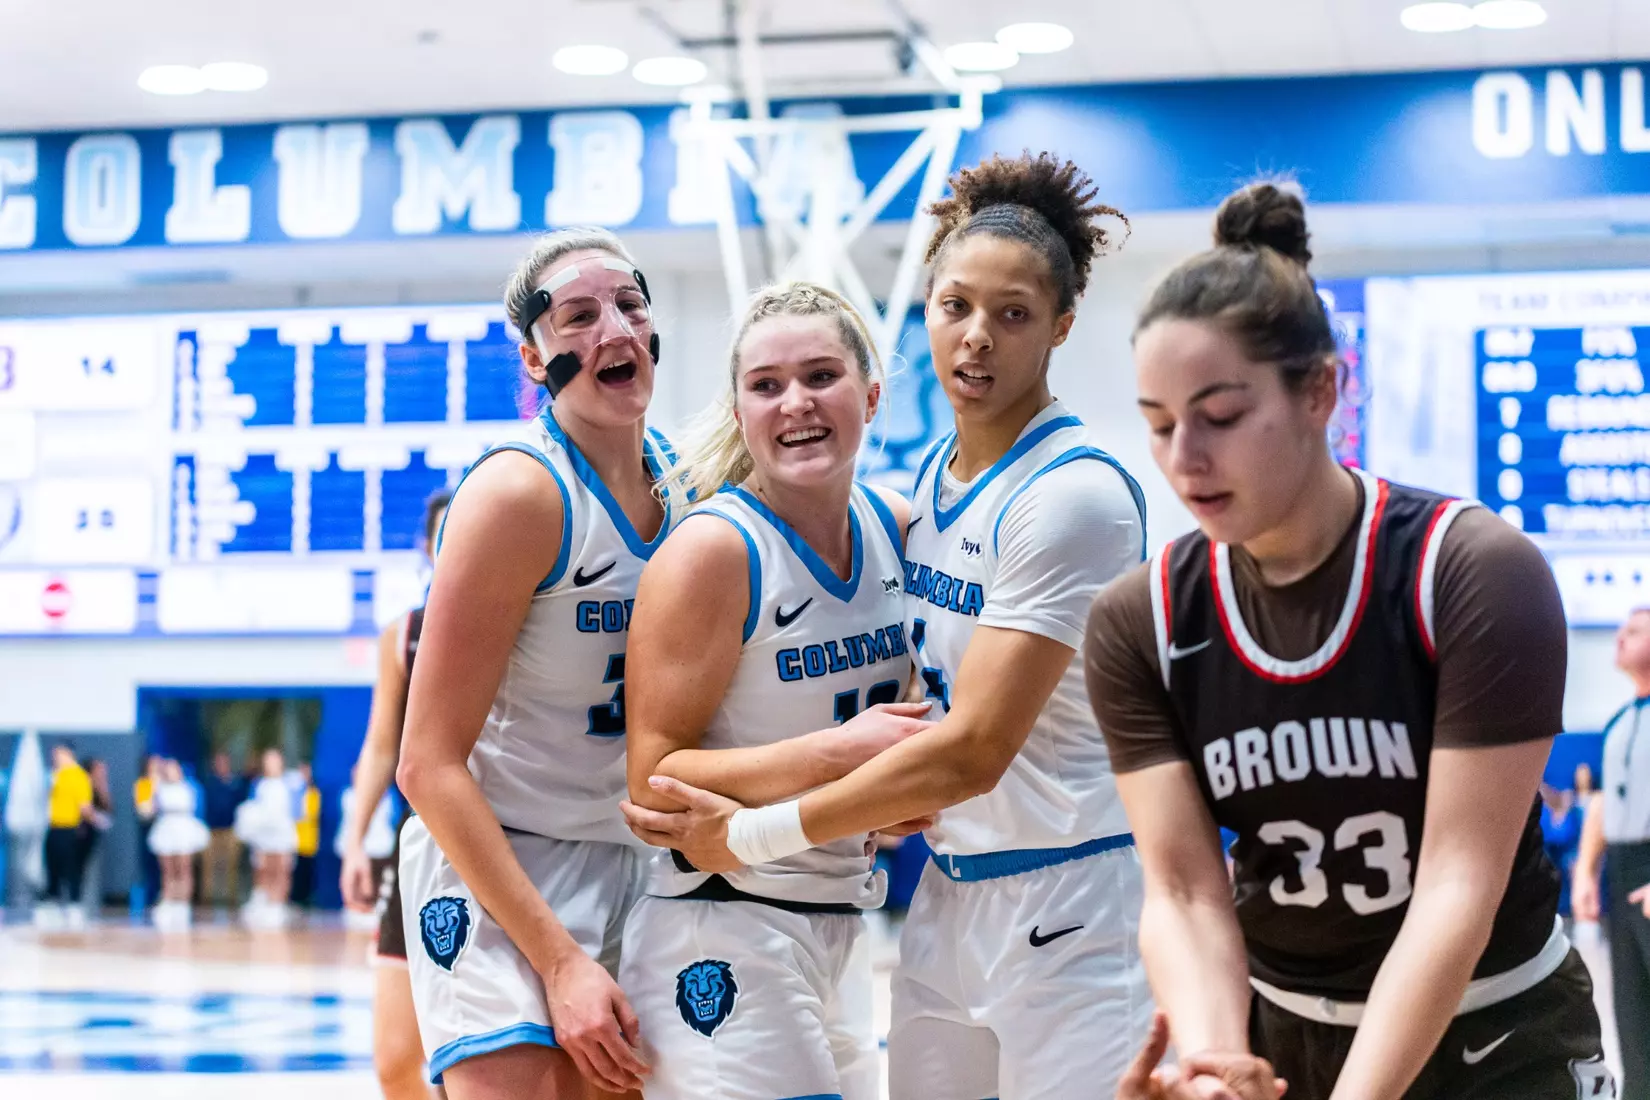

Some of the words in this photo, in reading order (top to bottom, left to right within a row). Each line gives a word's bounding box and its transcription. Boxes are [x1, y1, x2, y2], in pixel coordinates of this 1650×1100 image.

[961, 537, 975, 555] Ivy
[1203, 716, 1418, 801] BROWN
[1257, 810, 1412, 916] 33
